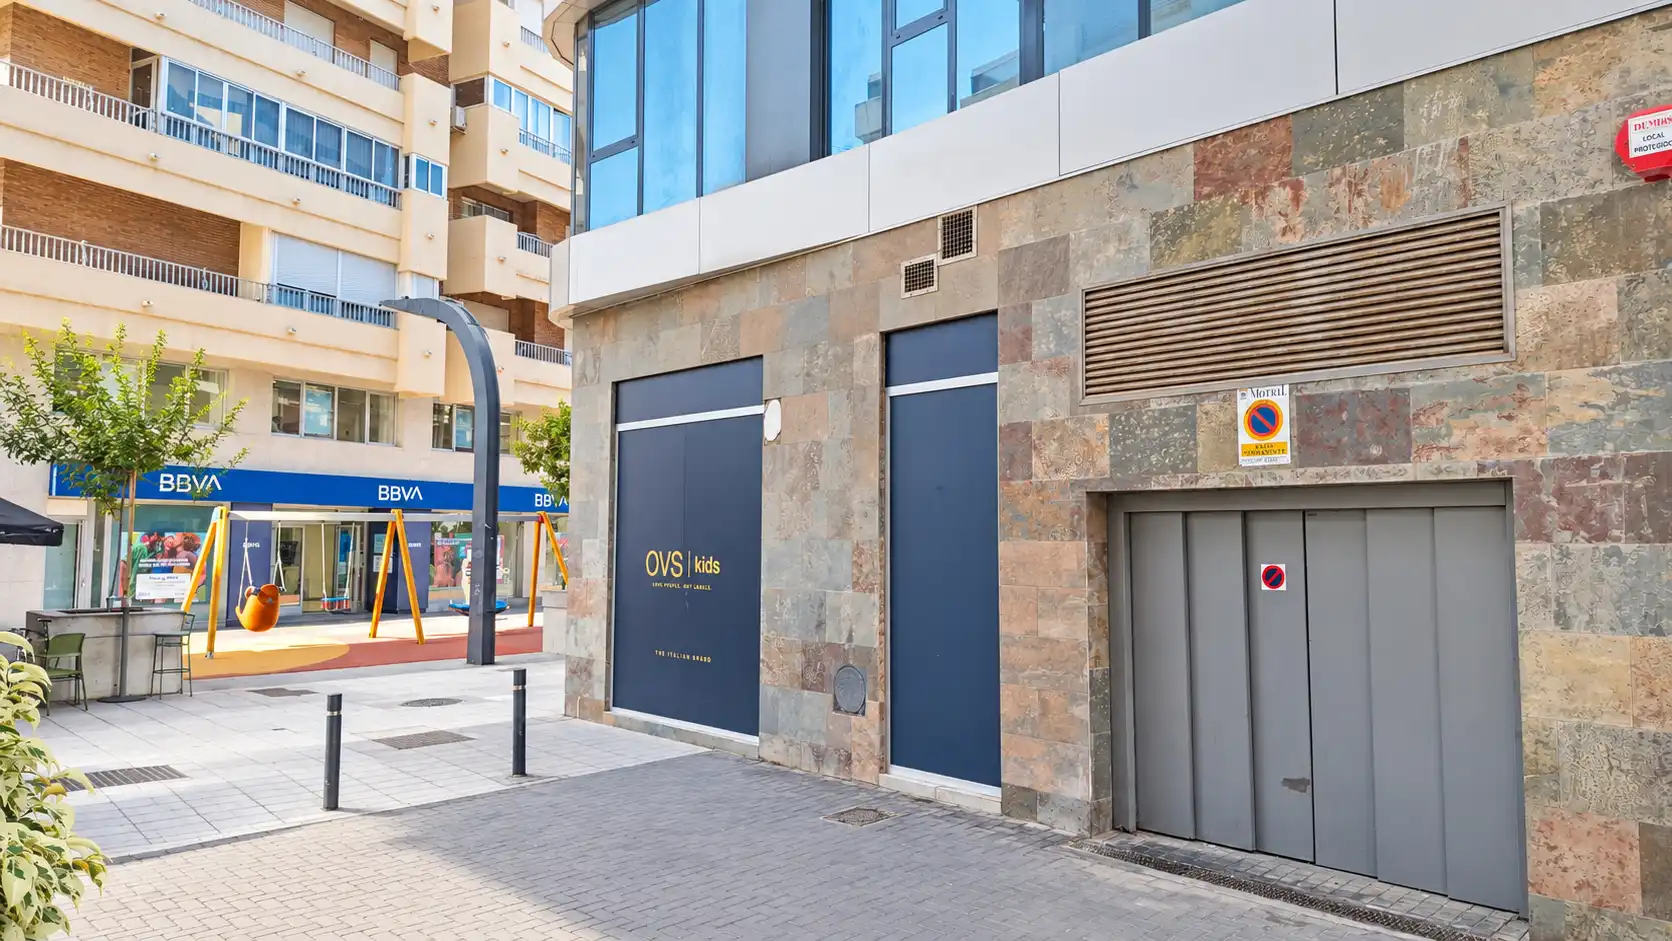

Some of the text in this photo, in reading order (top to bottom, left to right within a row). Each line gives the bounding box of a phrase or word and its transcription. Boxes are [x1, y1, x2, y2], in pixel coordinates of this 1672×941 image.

[1642, 132, 1665, 142] LOCAL
[159, 473, 222, 493] BBVA
[378, 485, 423, 501] BBVA
[645, 550, 721, 578] OVS kids
[667, 651, 690, 660] ITALIAN
